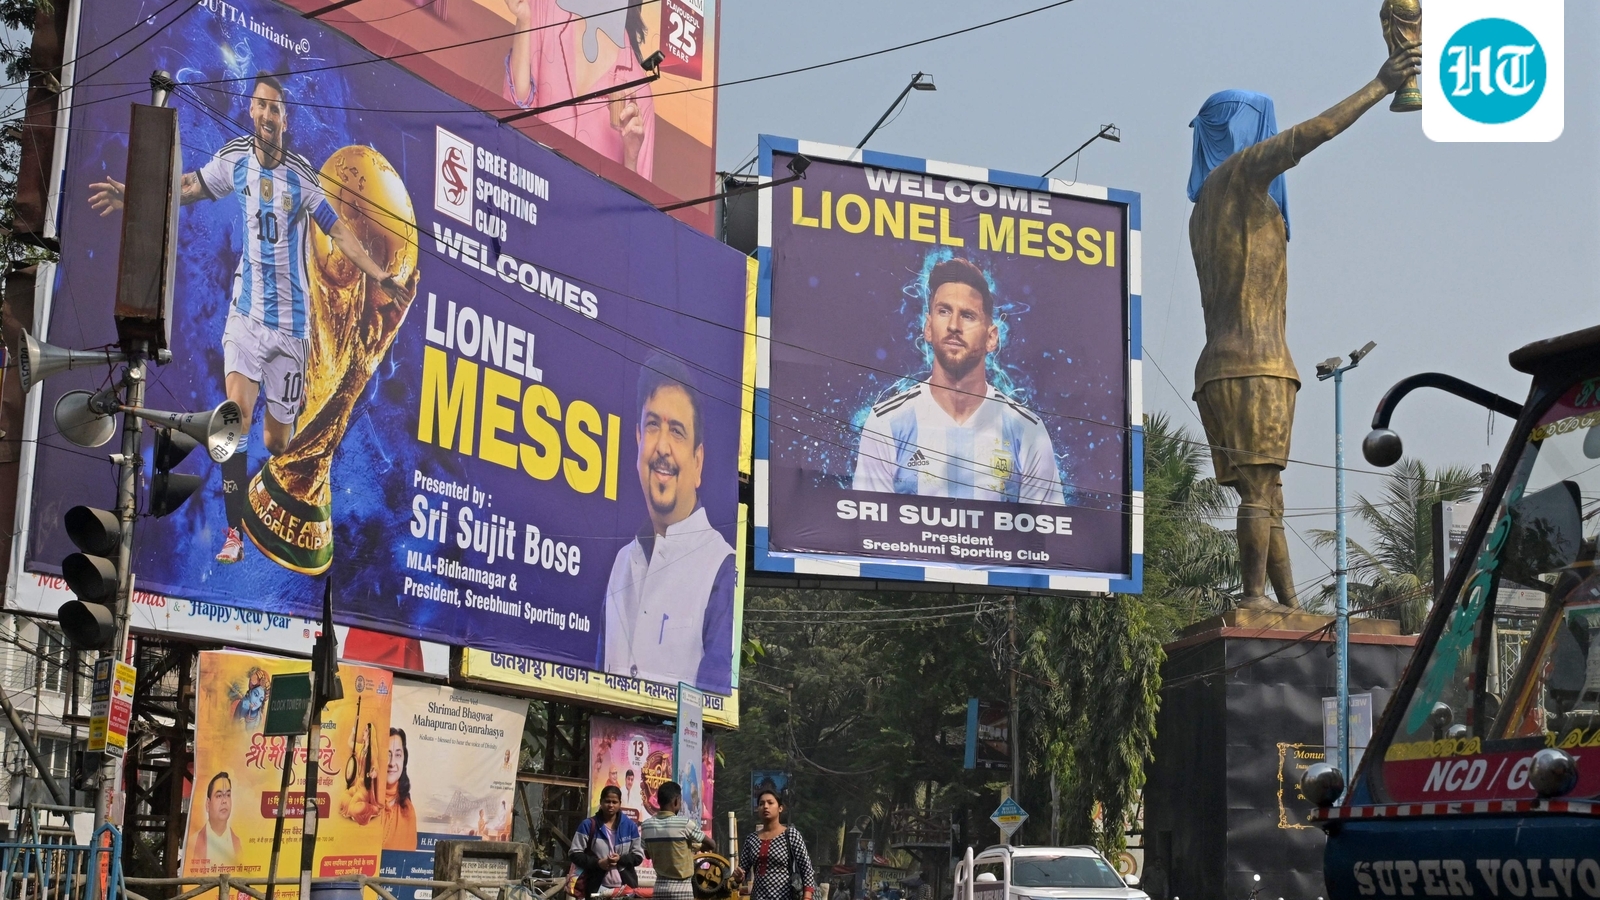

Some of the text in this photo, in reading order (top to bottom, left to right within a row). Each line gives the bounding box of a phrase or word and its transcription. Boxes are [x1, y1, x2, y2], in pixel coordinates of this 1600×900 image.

[668, 43, 689, 63] YEARS
[669, 12, 696, 57] 25
[476, 146, 508, 181] SREE
[509, 161, 549, 201] BHUMI
[863, 166, 1053, 216] WELCOME
[475, 177, 538, 226] SPORTING
[254, 208, 279, 245] 10
[475, 208, 508, 242] CLUB
[791, 186, 1116, 268] LIONEL MESSI
[432, 221, 599, 320] WELCOMES
[425, 291, 544, 384] LIONEL
[281, 370, 303, 403] 10
[416, 344, 622, 502] MESSI
[907, 459, 930, 468] adidas
[413, 469, 470, 502] Presented
[472, 485, 486, 509] by
[255, 501, 322, 551] WORLD CUP
[410, 494, 582, 577] Sri Sujit Bose
[836, 500, 1074, 536] SRI SUJIT BOSE
[862, 538, 1050, 562] Sreebhumi Sporting Club
[921, 531, 994, 546] President
[406, 549, 518, 592] MLA-Bidhannagar &
[172, 601, 181, 613] &
[187, 600, 232, 623] Happy
[233, 606, 262, 625] New
[262, 610, 292, 631] Year
[403, 576, 591, 633] President, Sreebhumi Sporting Club
[412, 713, 505, 739] Mahapuran Gyanrahasya
[427, 701, 494, 722] Shrimad Bhagwat
[632, 740, 644, 757] 13
[1422, 759, 1488, 792] NCD
[1353, 858, 1600, 898] SUPER VOLVO
